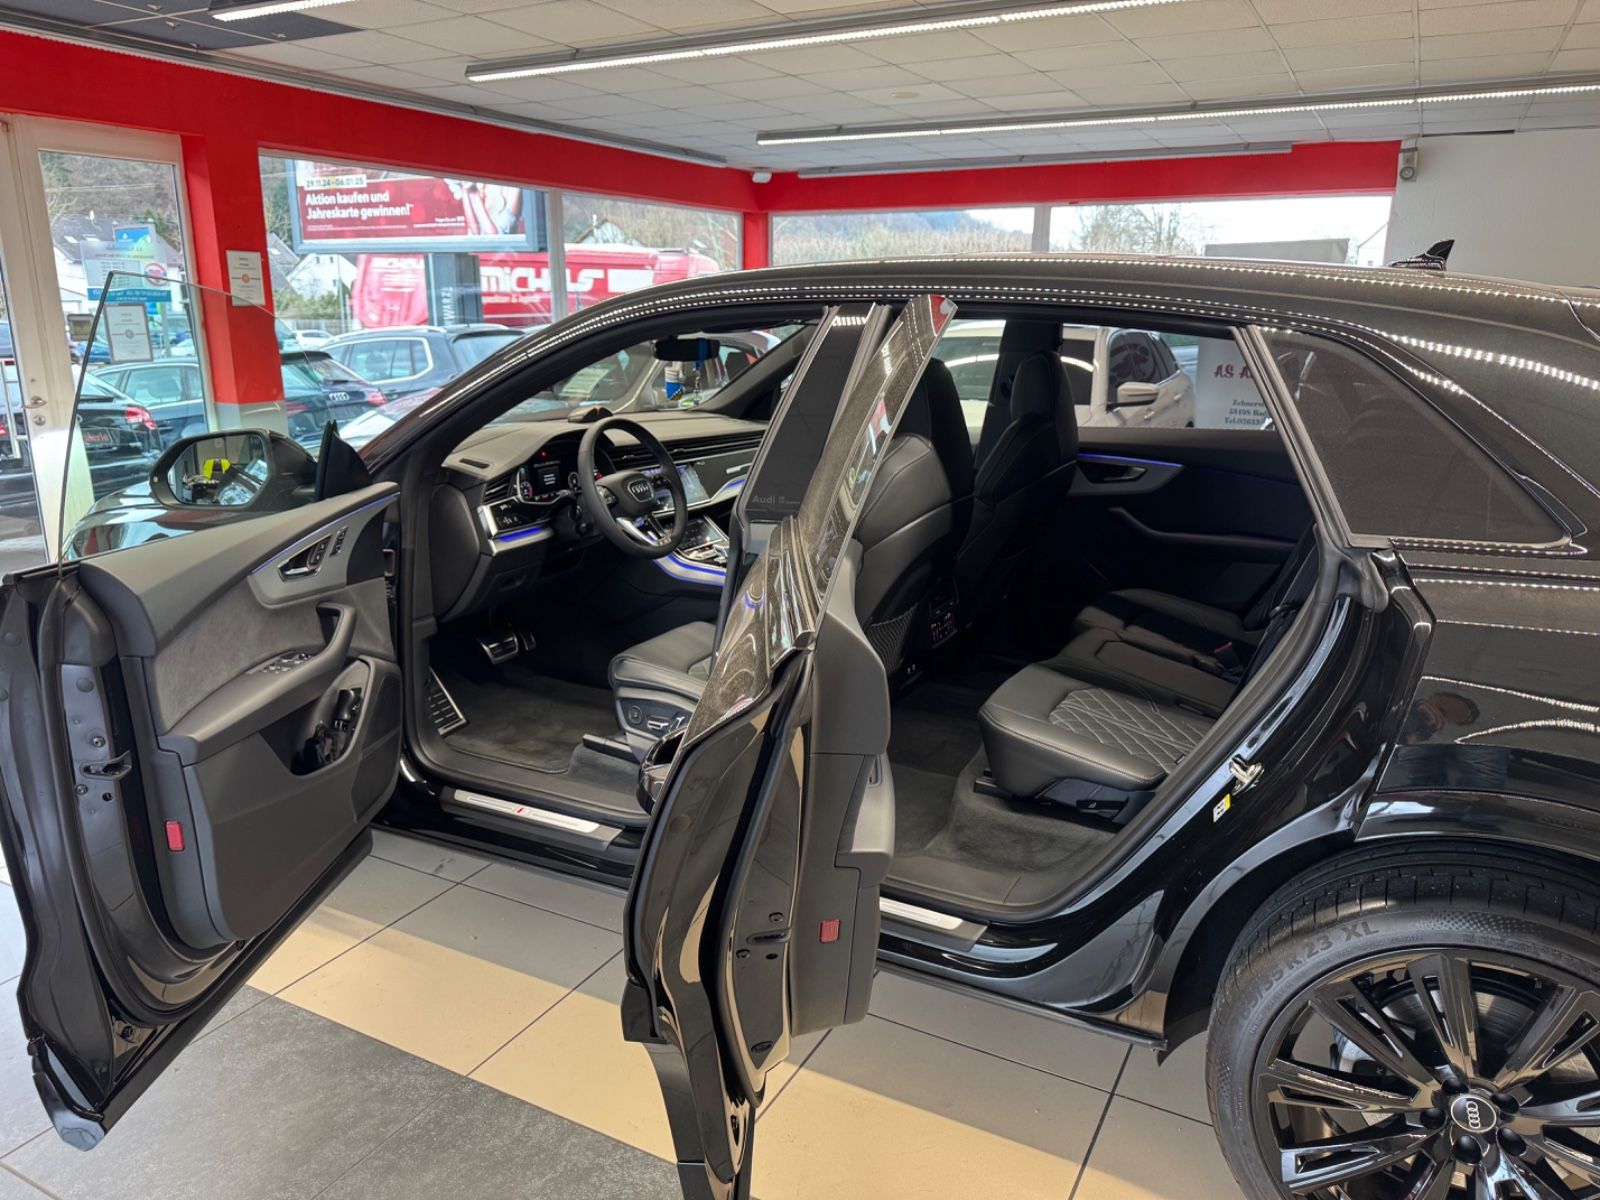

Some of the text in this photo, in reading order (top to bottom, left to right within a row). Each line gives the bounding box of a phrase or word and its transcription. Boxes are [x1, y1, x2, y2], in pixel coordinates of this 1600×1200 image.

[306, 190, 389, 206] Aktion kaufen und
[307, 207, 359, 219] Jahreskarte
[752, 496, 775, 504] Audi
[1341, 920, 1379, 941] XL
